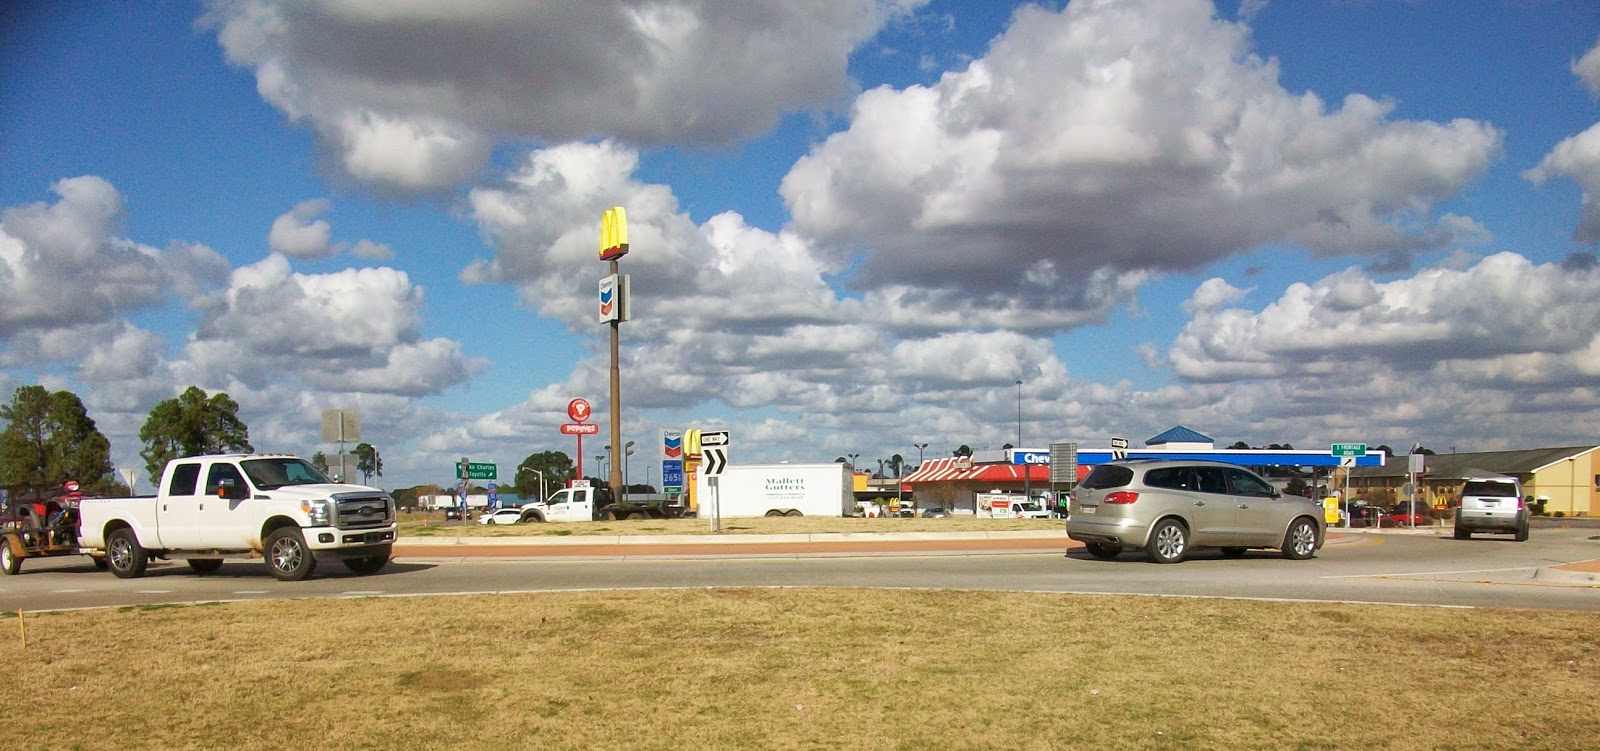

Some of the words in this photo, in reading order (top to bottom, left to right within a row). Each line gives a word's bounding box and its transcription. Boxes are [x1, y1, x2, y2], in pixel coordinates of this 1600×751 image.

[566, 425, 596, 433] POPEYES
[1024, 453, 1051, 464] Chev
[664, 474, 678, 482] 265
